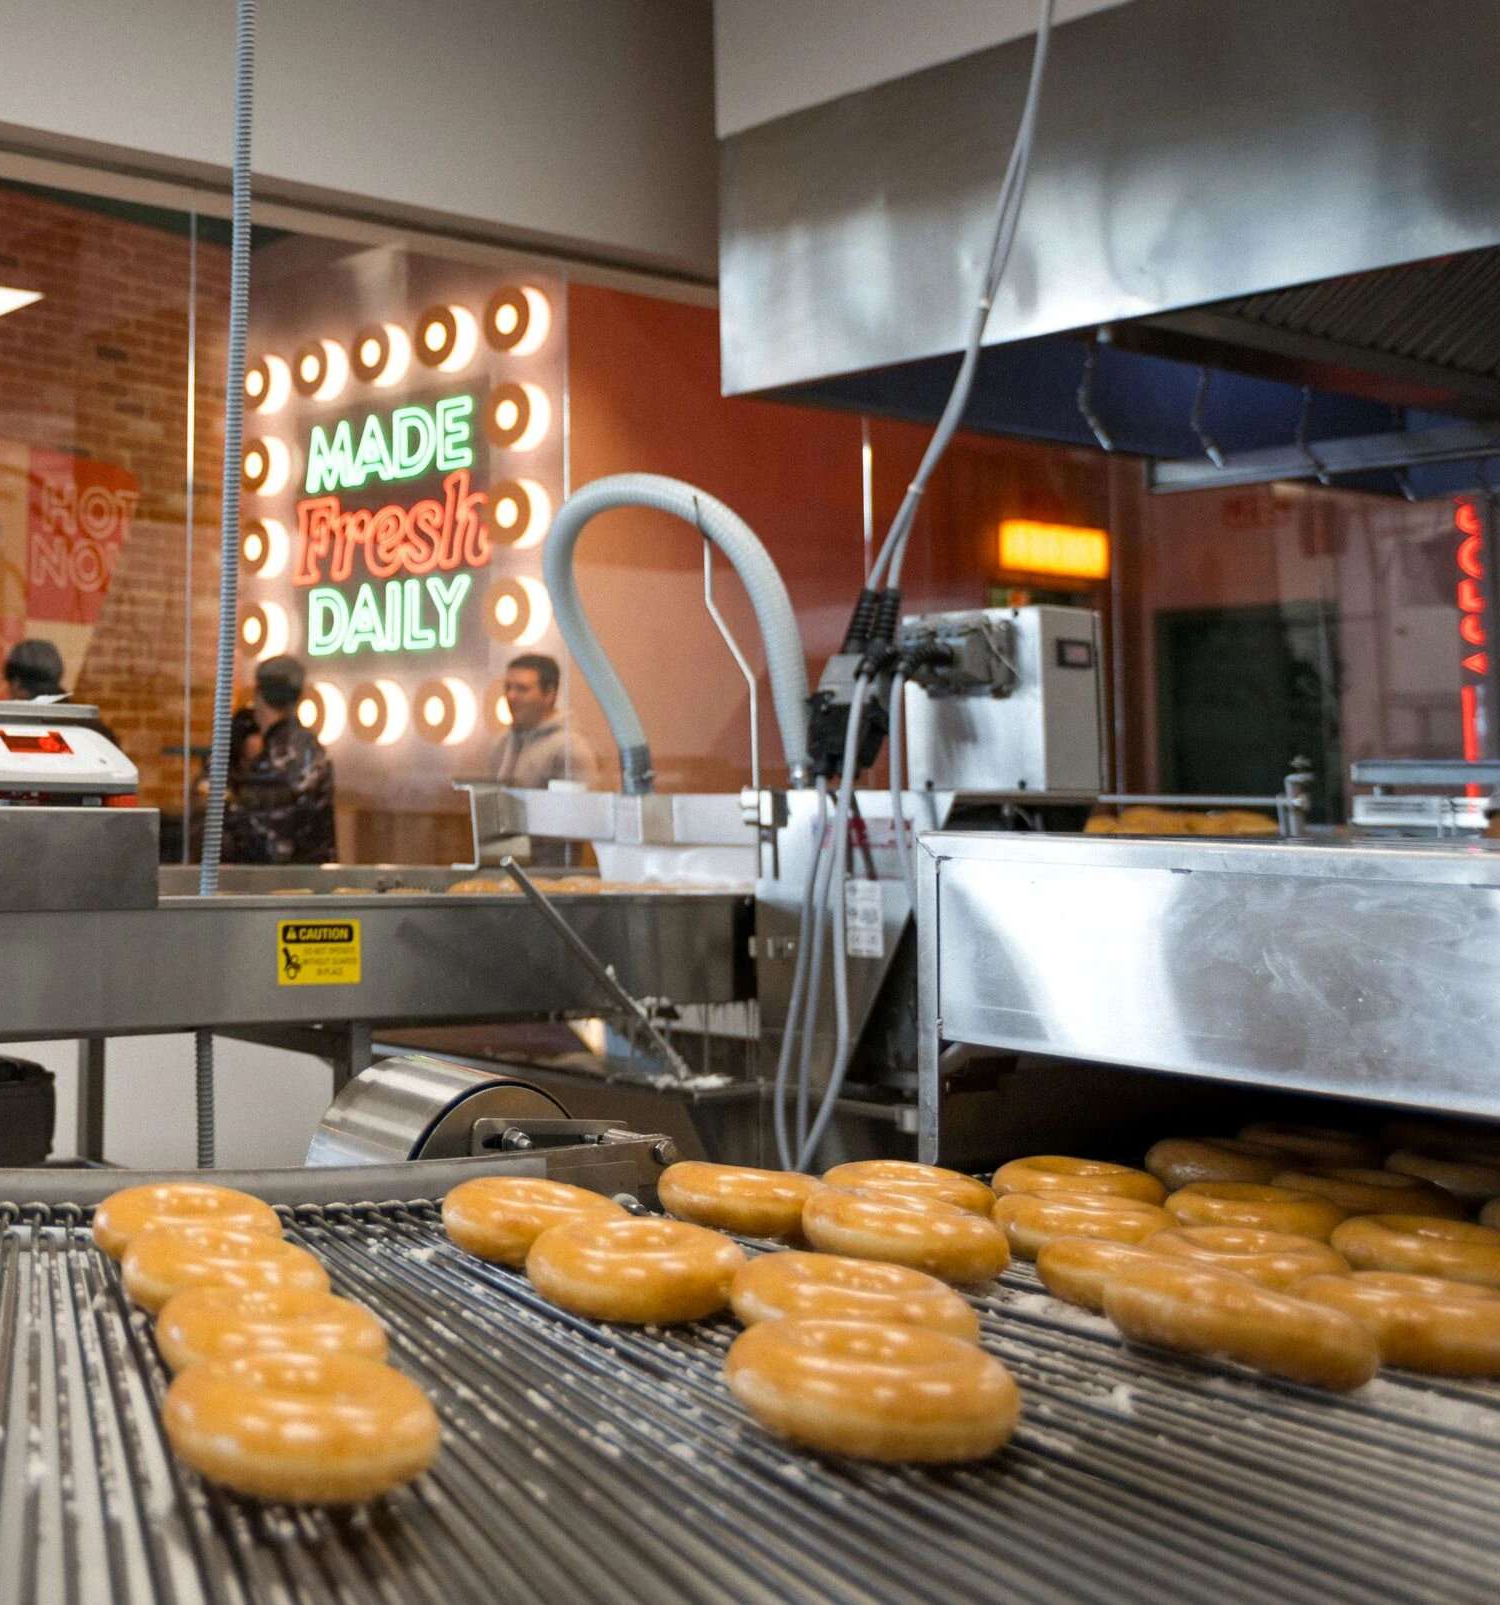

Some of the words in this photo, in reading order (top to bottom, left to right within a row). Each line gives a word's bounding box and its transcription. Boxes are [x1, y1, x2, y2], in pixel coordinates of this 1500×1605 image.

[305, 394, 474, 494] MADE
[292, 468, 494, 587] Fresh
[307, 573, 471, 656] DAILY
[299, 926, 350, 941] CAUTION
